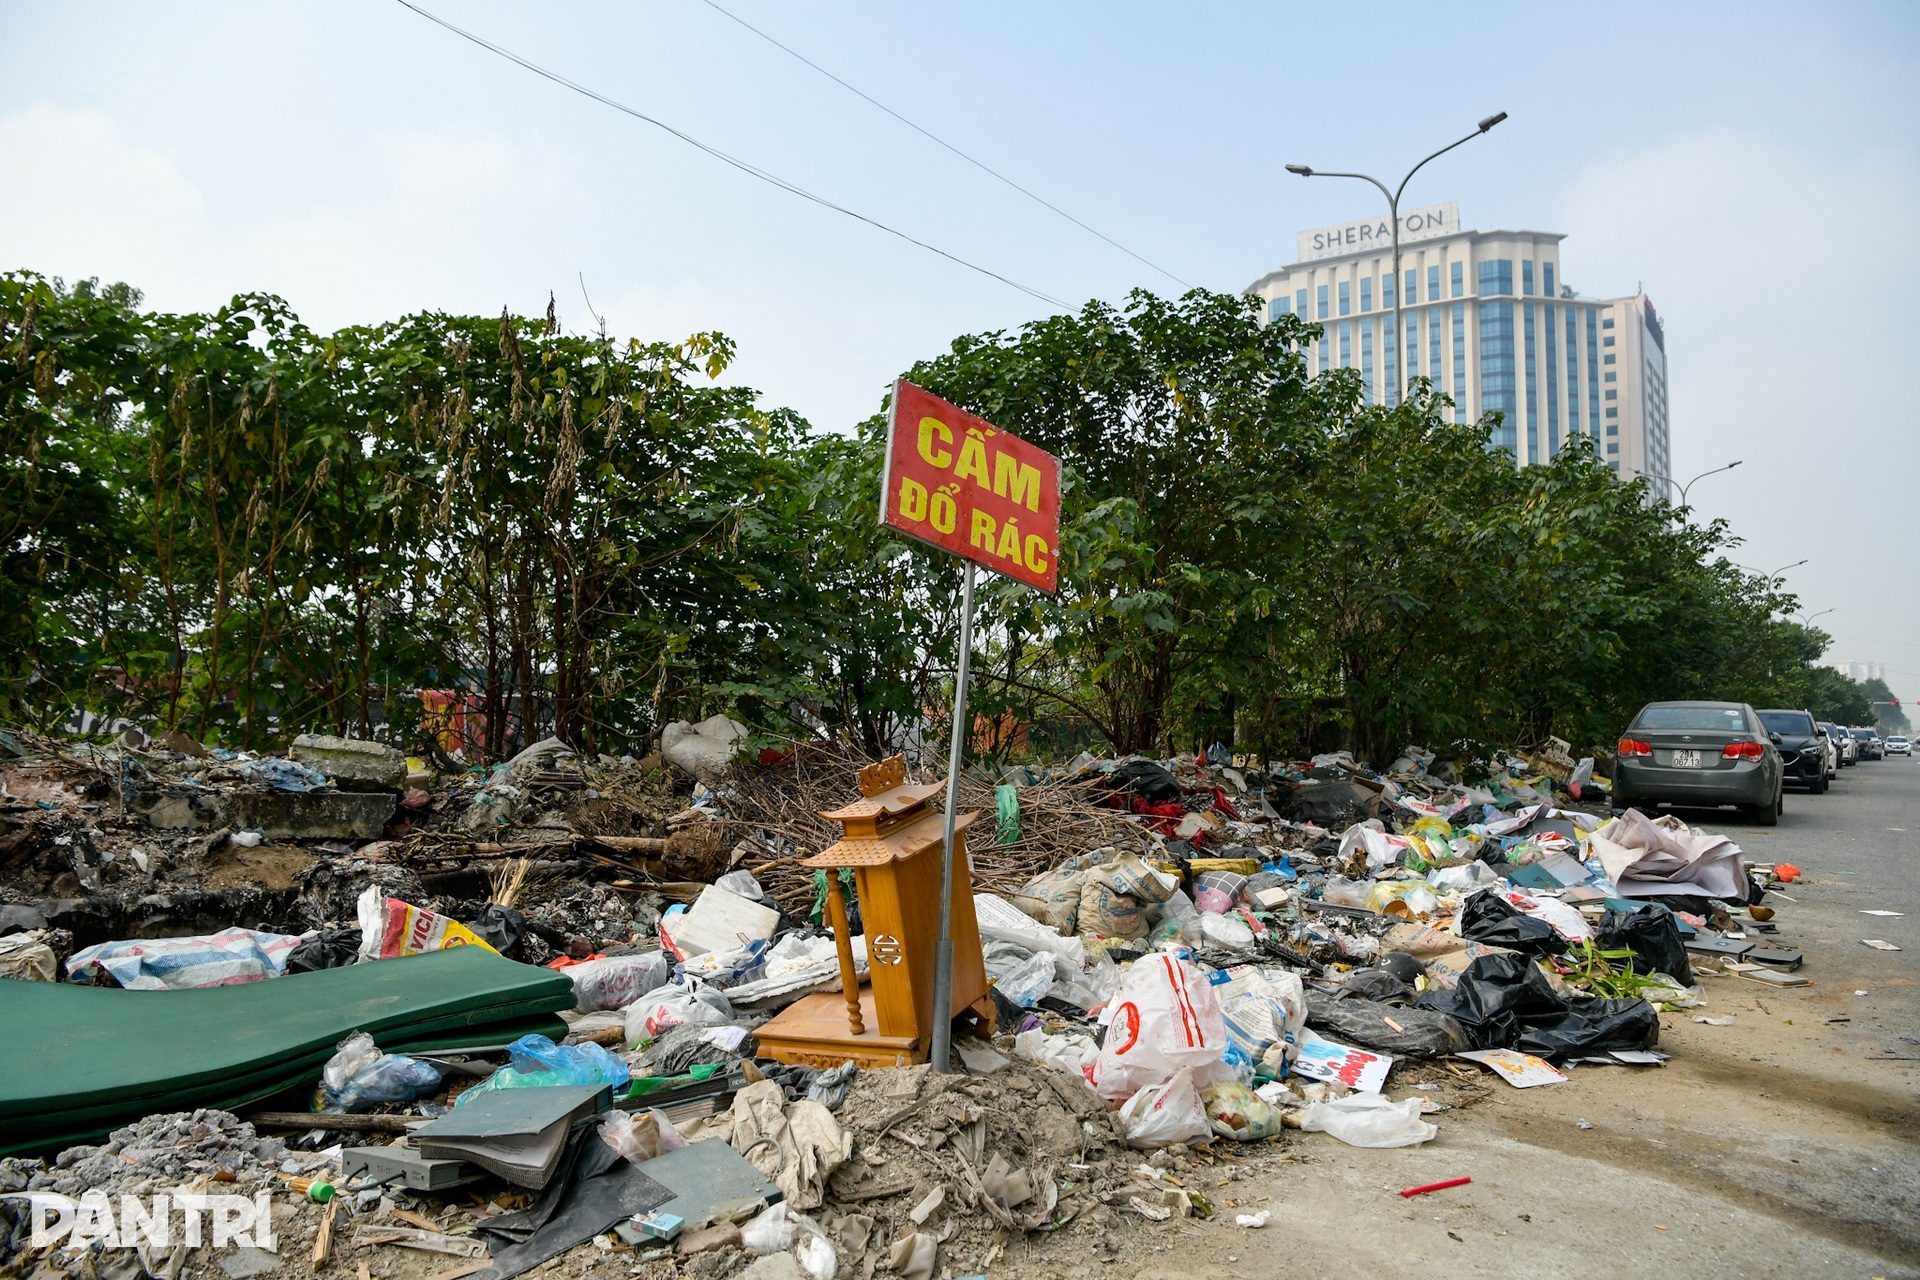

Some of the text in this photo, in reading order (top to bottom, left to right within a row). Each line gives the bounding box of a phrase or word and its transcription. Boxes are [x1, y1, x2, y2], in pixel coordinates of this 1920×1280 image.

[1312, 210, 1443, 250] SHERAON
[917, 416, 1041, 514] CẤM
[899, 476, 1049, 574] ĐỔ RÁC
[1679, 750, 1694, 758] 29A
